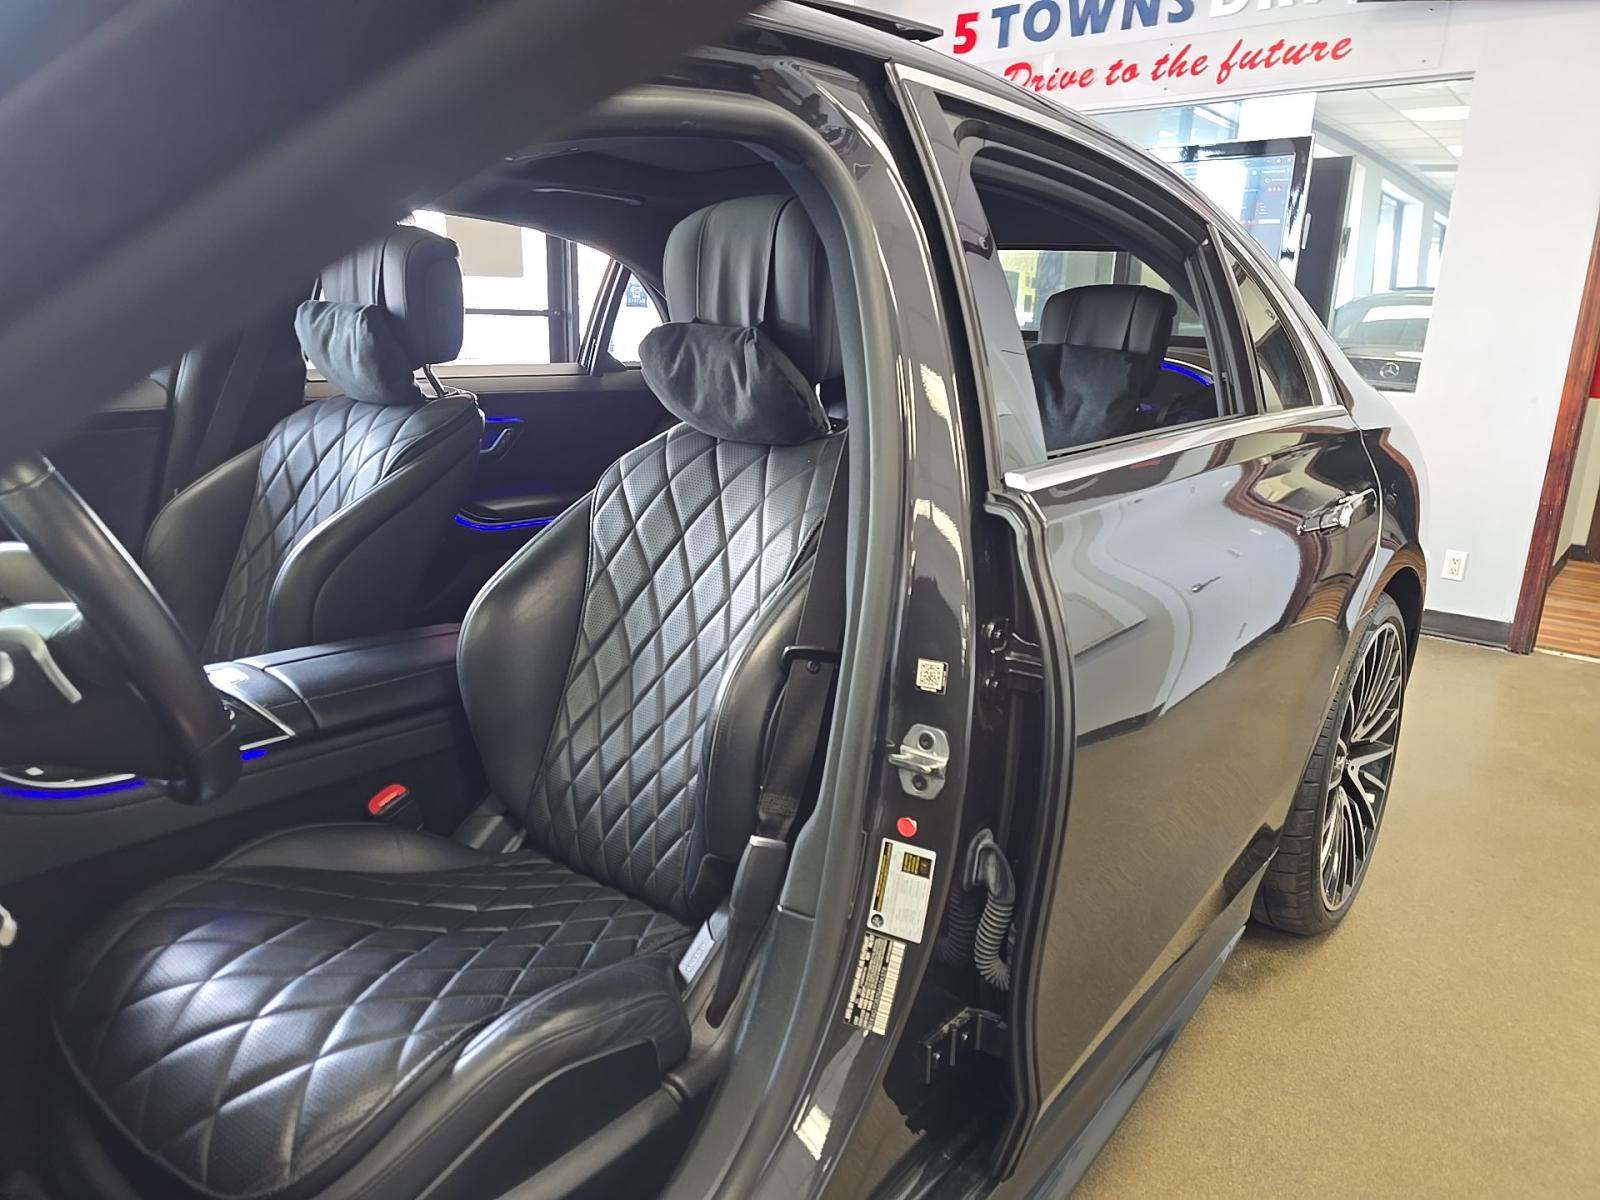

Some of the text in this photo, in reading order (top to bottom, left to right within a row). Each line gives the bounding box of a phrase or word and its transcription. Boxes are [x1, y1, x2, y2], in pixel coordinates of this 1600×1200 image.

[953, 12, 979, 54] 5
[1004, 37, 1352, 92] Drive to the future
